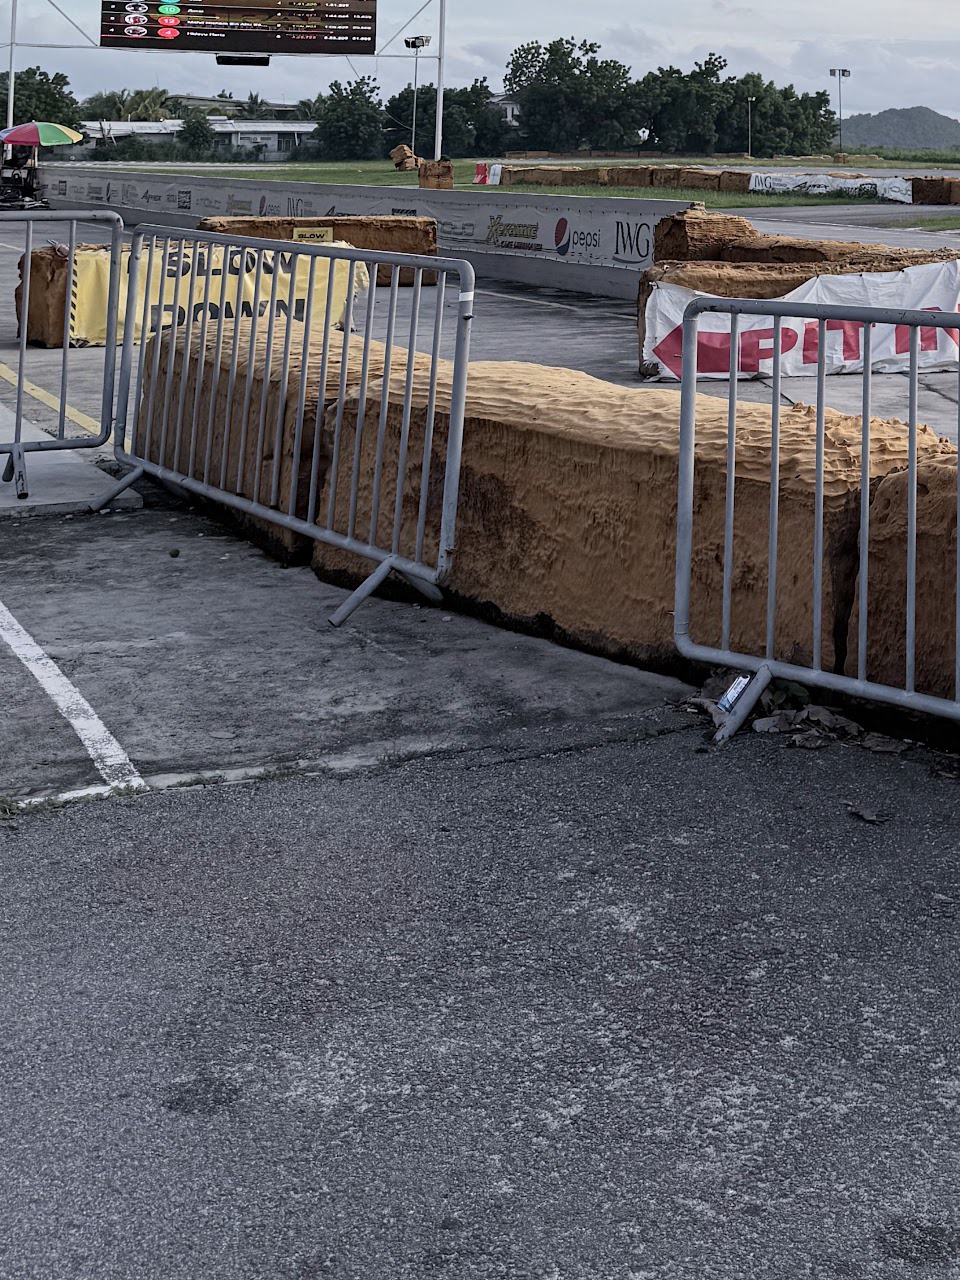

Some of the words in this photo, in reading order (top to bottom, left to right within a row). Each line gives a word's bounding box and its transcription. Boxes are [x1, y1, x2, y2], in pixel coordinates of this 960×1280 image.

[572, 229, 601, 252] pepsi
[614, 221, 650, 258] IWG
[162, 249, 297, 278] SLOW
[150, 298, 306, 332] DOWN
[740, 320, 876, 372] PIT
